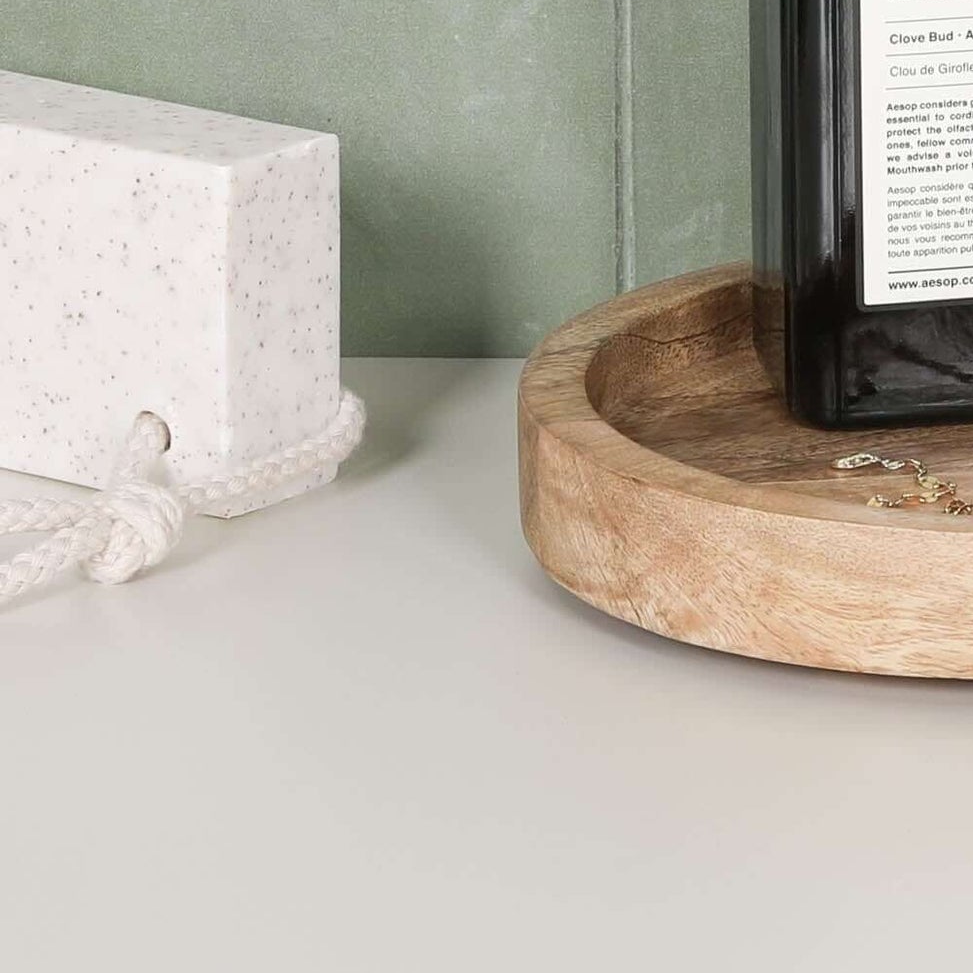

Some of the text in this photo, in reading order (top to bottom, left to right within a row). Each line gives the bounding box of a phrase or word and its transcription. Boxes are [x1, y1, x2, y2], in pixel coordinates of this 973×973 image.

[889, 33, 925, 45] Clove
[928, 30, 954, 42] Bud
[889, 65, 916, 77] Clou
[919, 64, 934, 75] de
[886, 102, 918, 112] Aesop
[918, 99, 968, 109] considers
[885, 113, 930, 124] essential
[934, 112, 945, 121] to
[886, 126, 921, 139] protect
[925, 126, 942, 134] the
[886, 141, 913, 150] ones,
[916, 138, 946, 147] fellow
[886, 154, 900, 162] we
[906, 151, 939, 161] advise
[944, 151, 951, 159] a
[886, 163, 943, 175] Mouthwash
[945, 162, 968, 173] prior
[886, 223, 899, 233] de
[900, 223, 918, 232] vos
[887, 237, 910, 245] nous
[914, 235, 936, 243] vous
